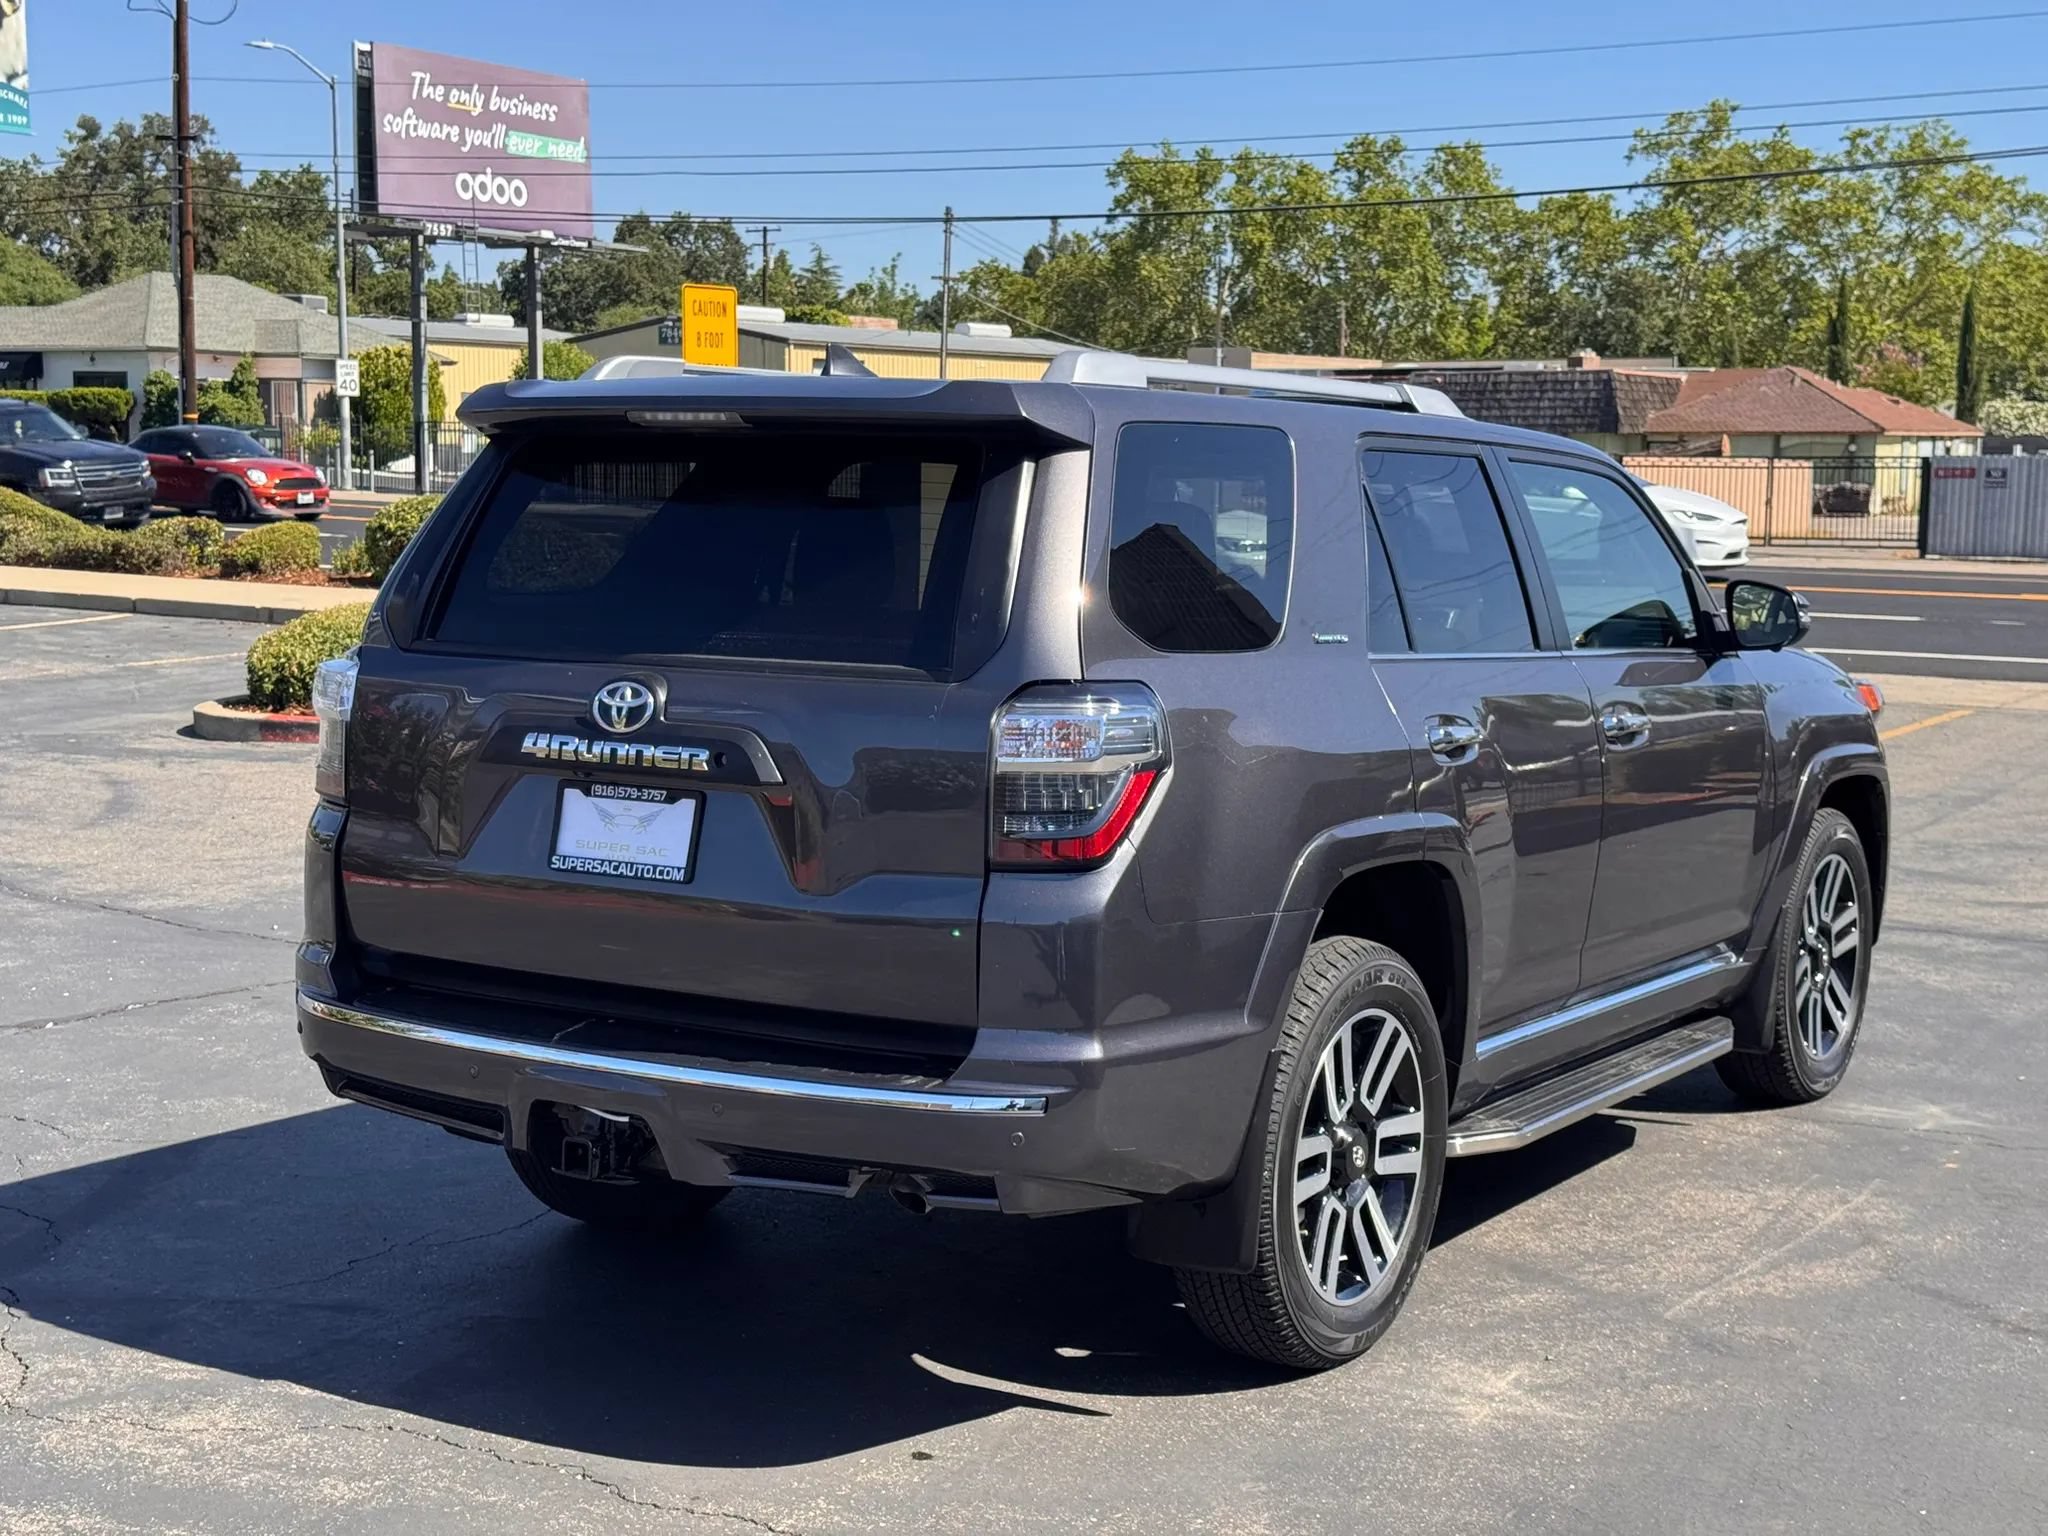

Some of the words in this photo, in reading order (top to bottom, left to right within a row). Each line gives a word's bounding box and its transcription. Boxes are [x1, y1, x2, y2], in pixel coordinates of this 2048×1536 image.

[411, 71, 444, 101] The
[449, 84, 485, 116] only
[490, 86, 559, 122] business
[383, 107, 460, 140] software
[461, 123, 506, 152] you'll
[509, 135, 541, 154] ever
[455, 167, 528, 207] odoo
[424, 222, 453, 237] 7557
[693, 300, 728, 318] CAUTION
[704, 332, 724, 349] FOOT
[340, 379, 357, 392] 40
[521, 732, 710, 771] 4RUNNER
[591, 783, 668, 801] (916)579-3757
[575, 839, 630, 853] SUPER
[636, 846, 671, 858] SAC
[550, 855, 685, 881] SUPERSACAUTO.COM
